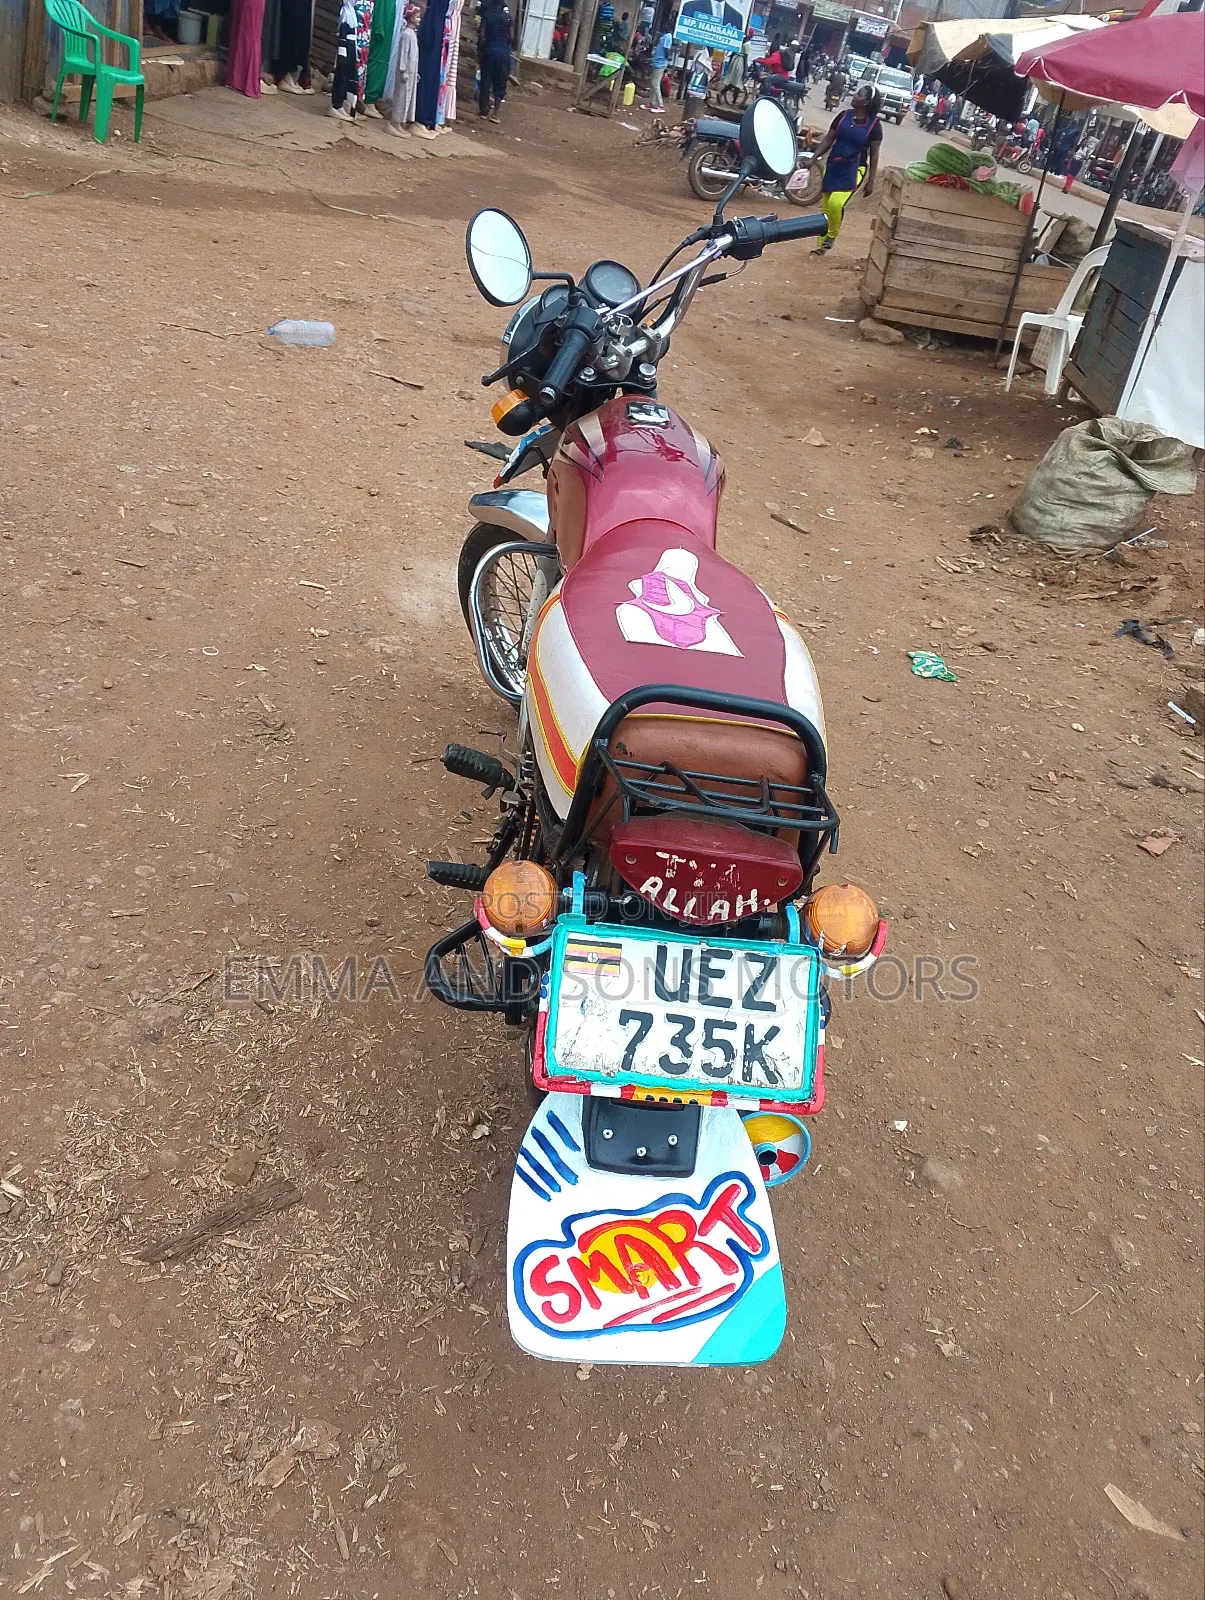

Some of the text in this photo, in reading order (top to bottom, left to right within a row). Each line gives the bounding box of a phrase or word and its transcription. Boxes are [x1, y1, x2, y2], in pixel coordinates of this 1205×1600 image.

[687, 28, 732, 44] MUNICIPALITY
[654, 944, 778, 1013] UEZ
[618, 1008, 781, 1085] 735K
[530, 1183, 762, 1324] SMART
